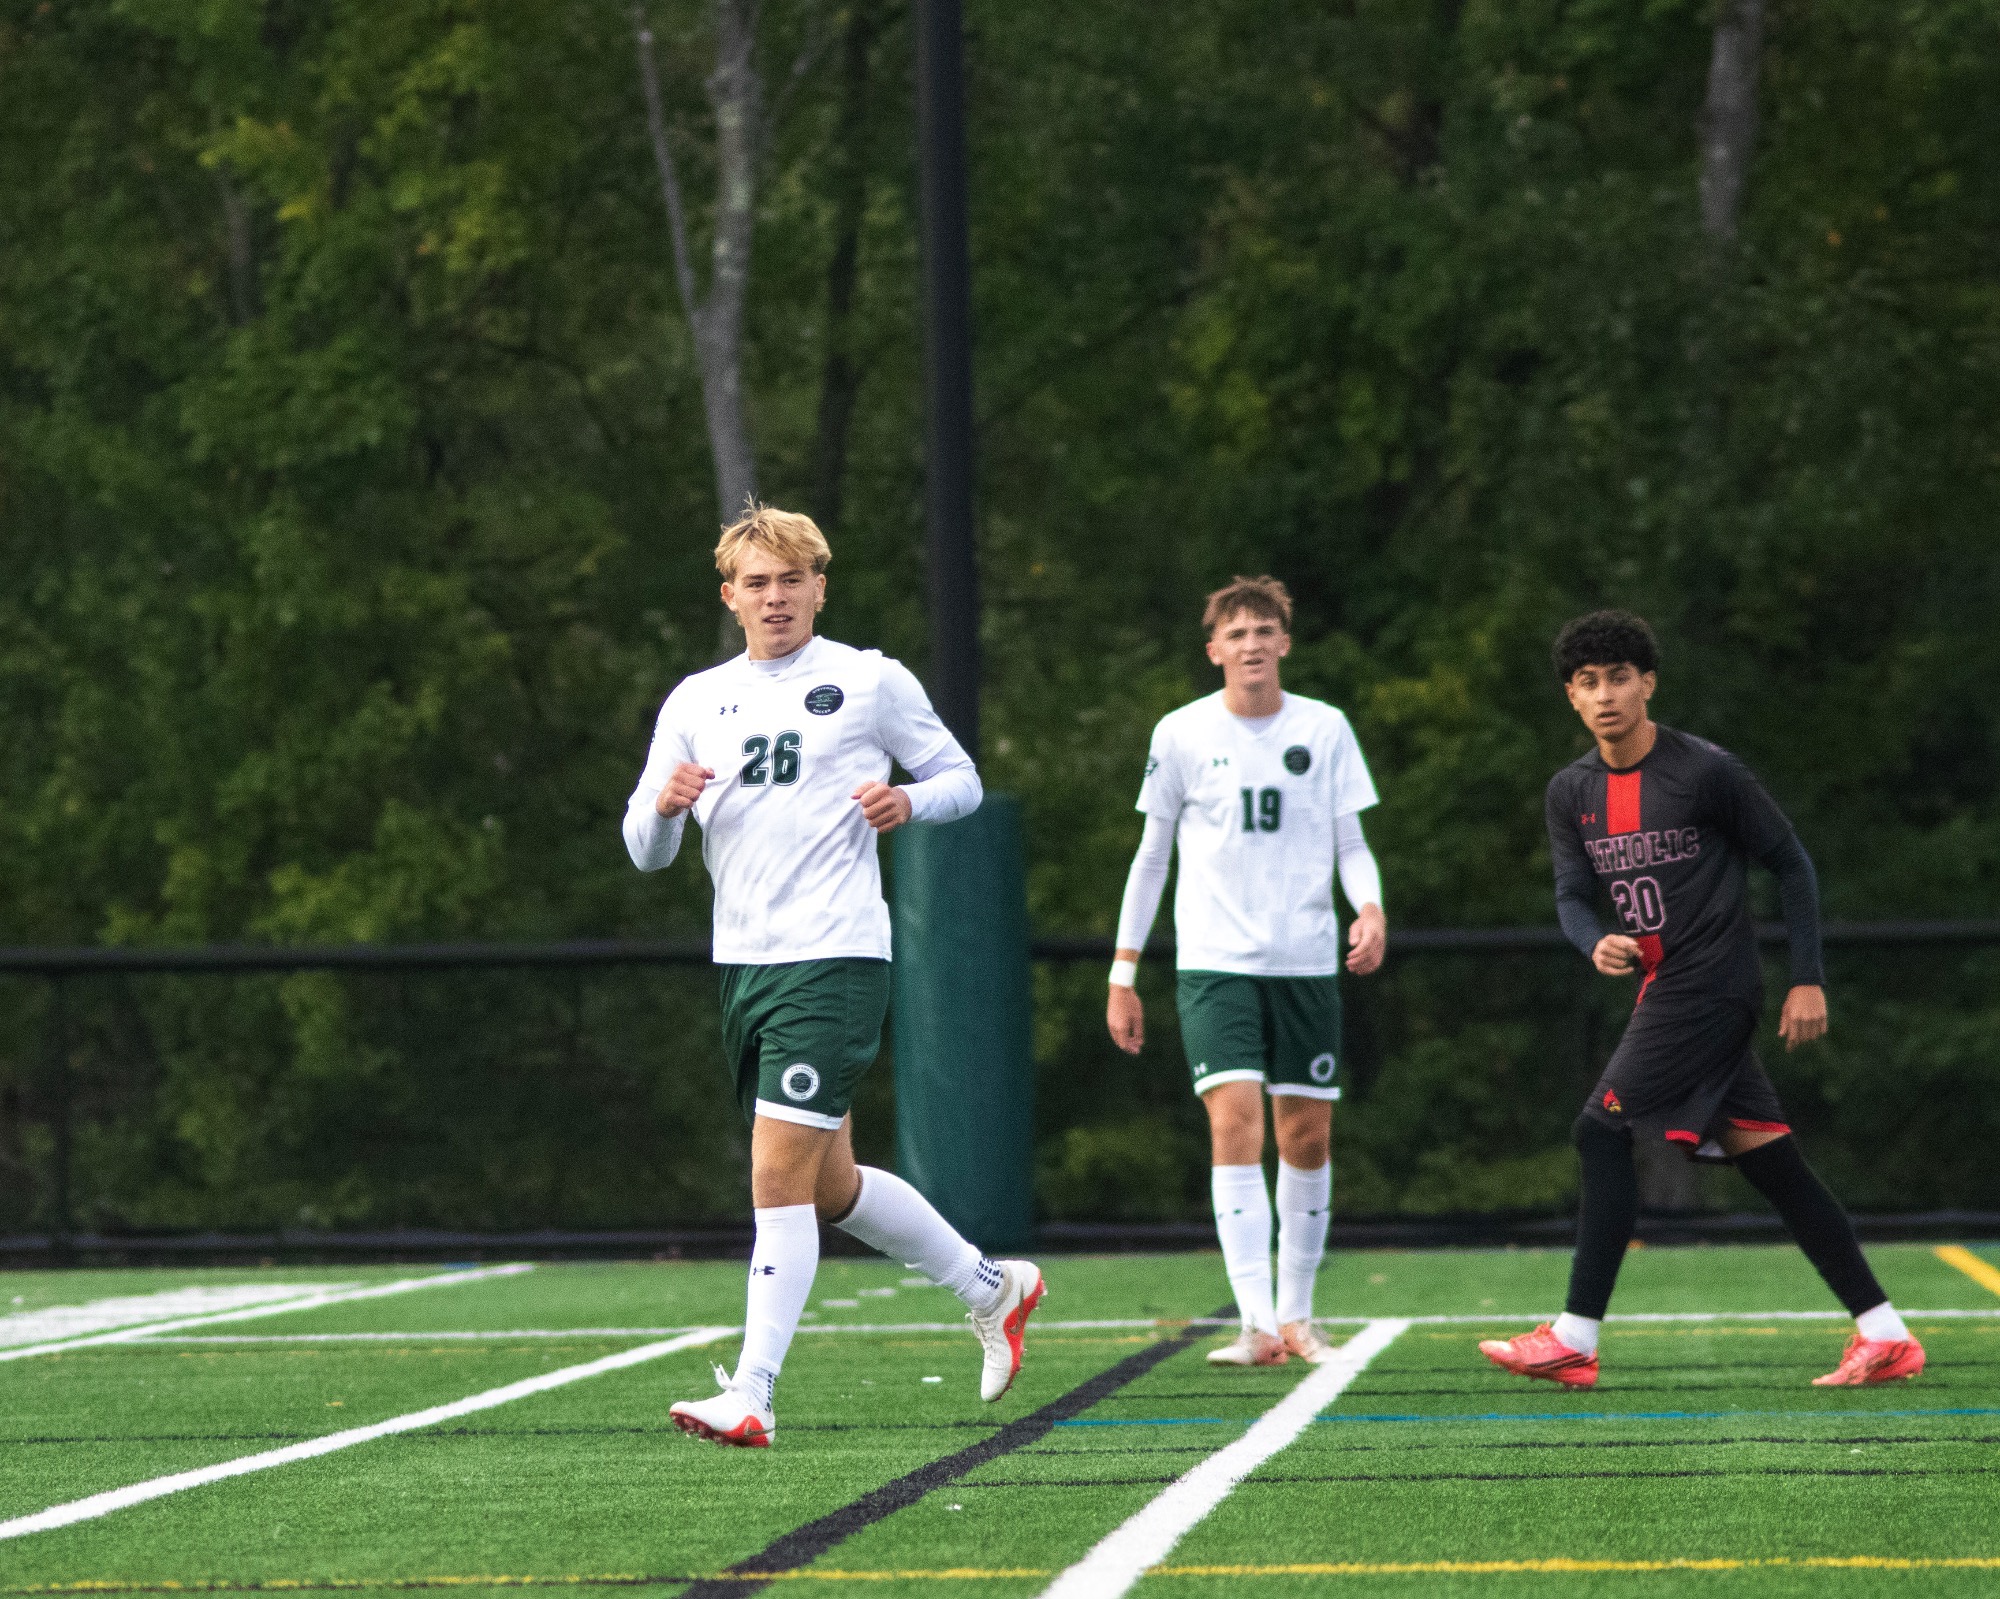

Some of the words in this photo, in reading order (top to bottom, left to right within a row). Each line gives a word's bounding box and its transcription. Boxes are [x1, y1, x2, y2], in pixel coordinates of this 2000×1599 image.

[740, 729, 803, 787] 26
[1240, 786, 1281, 833] 19
[1584, 827, 1700, 873] THOLIC
[1611, 876, 1666, 933] 20
